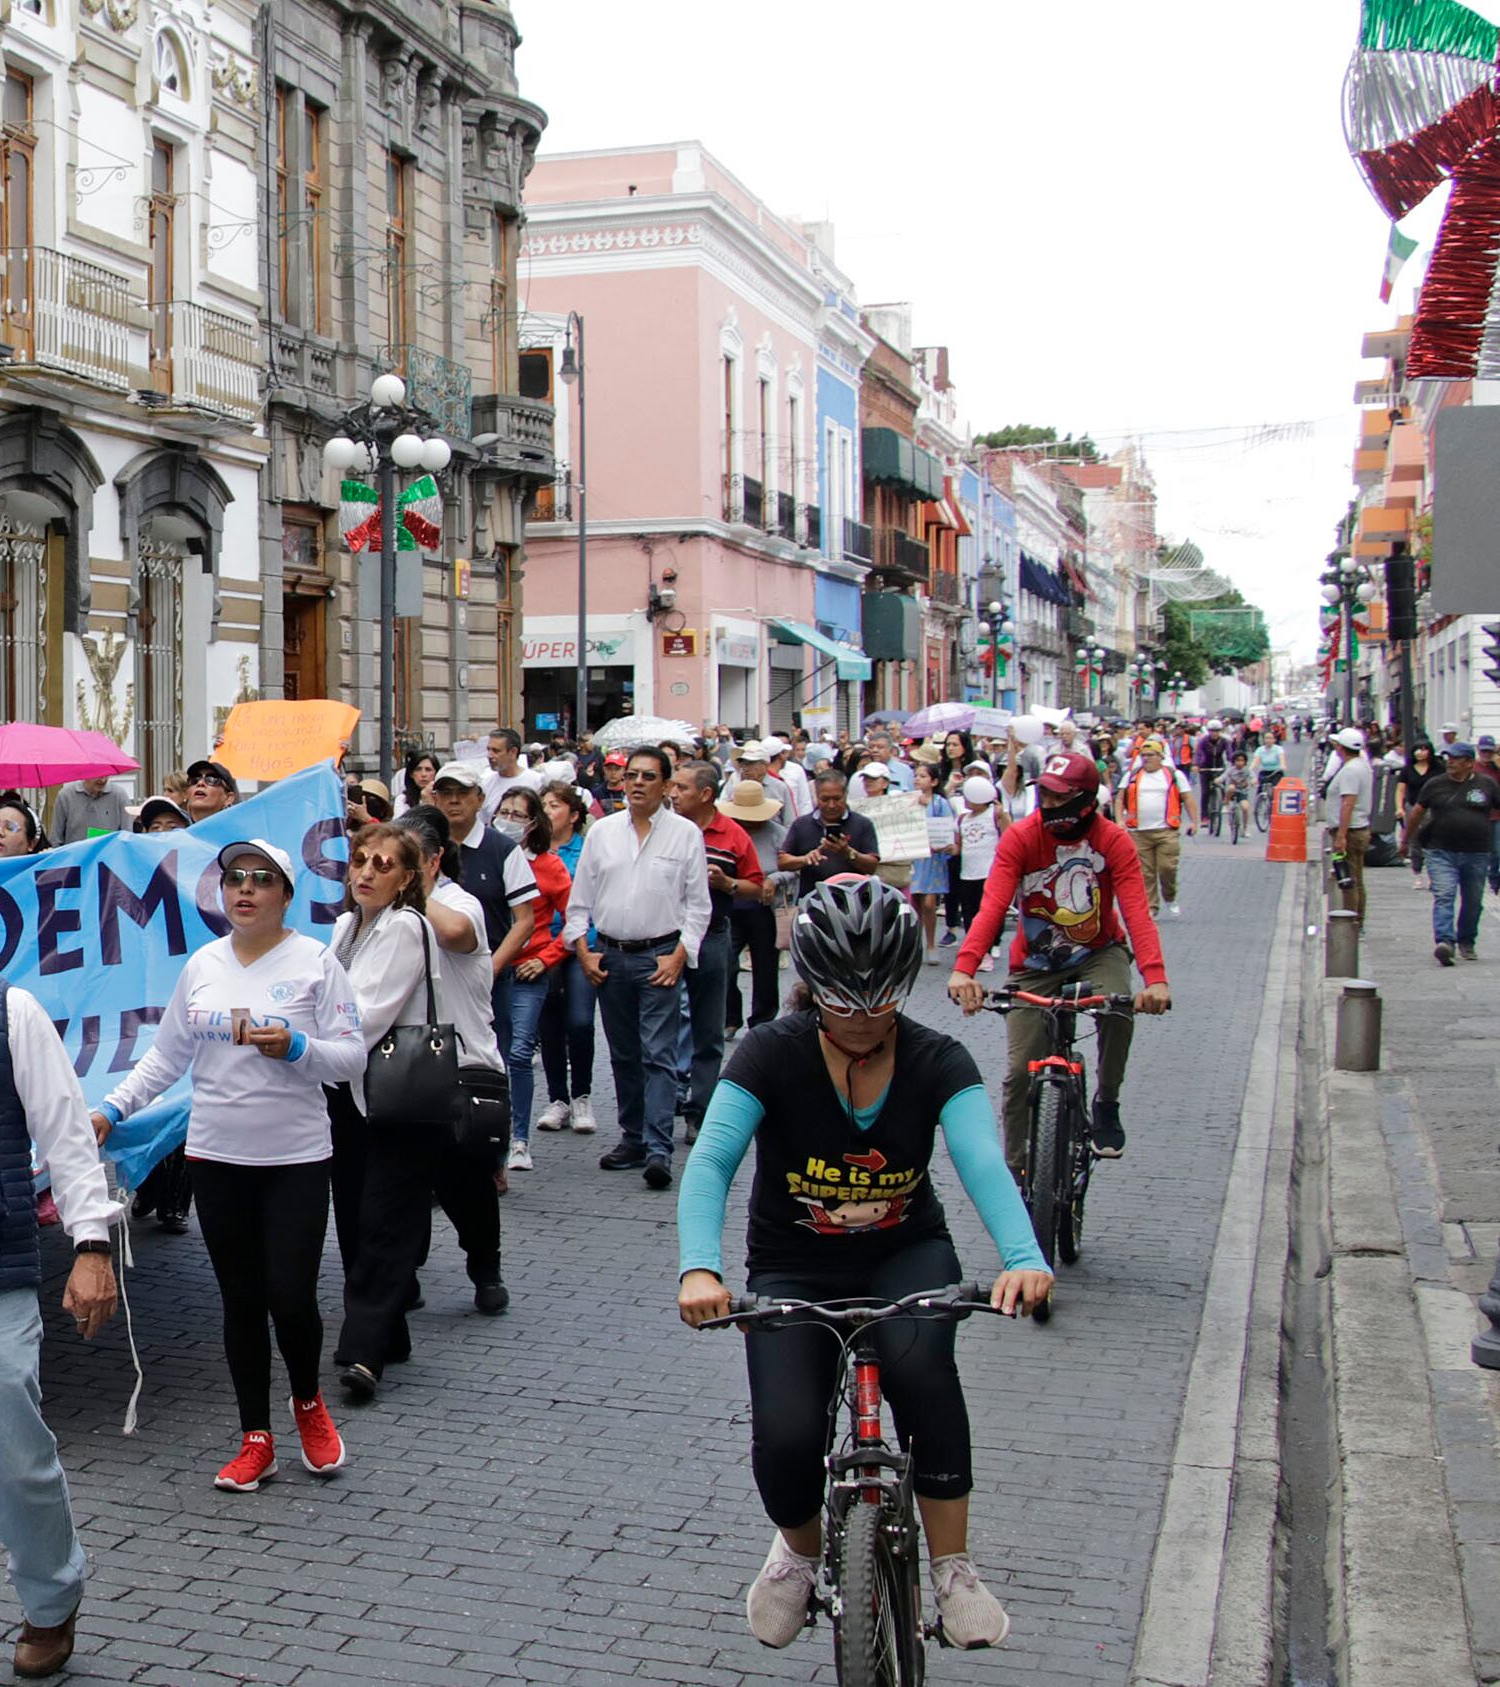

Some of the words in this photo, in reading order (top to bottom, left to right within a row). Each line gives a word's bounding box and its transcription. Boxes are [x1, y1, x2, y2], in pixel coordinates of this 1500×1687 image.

[1280, 790, 1298, 813] E
[806, 1157, 841, 1182] He
[849, 1166, 871, 1185] is
[879, 1168, 915, 1186] my
[302, 1401, 318, 1411] UA
[249, 1434, 266, 1444] UA
